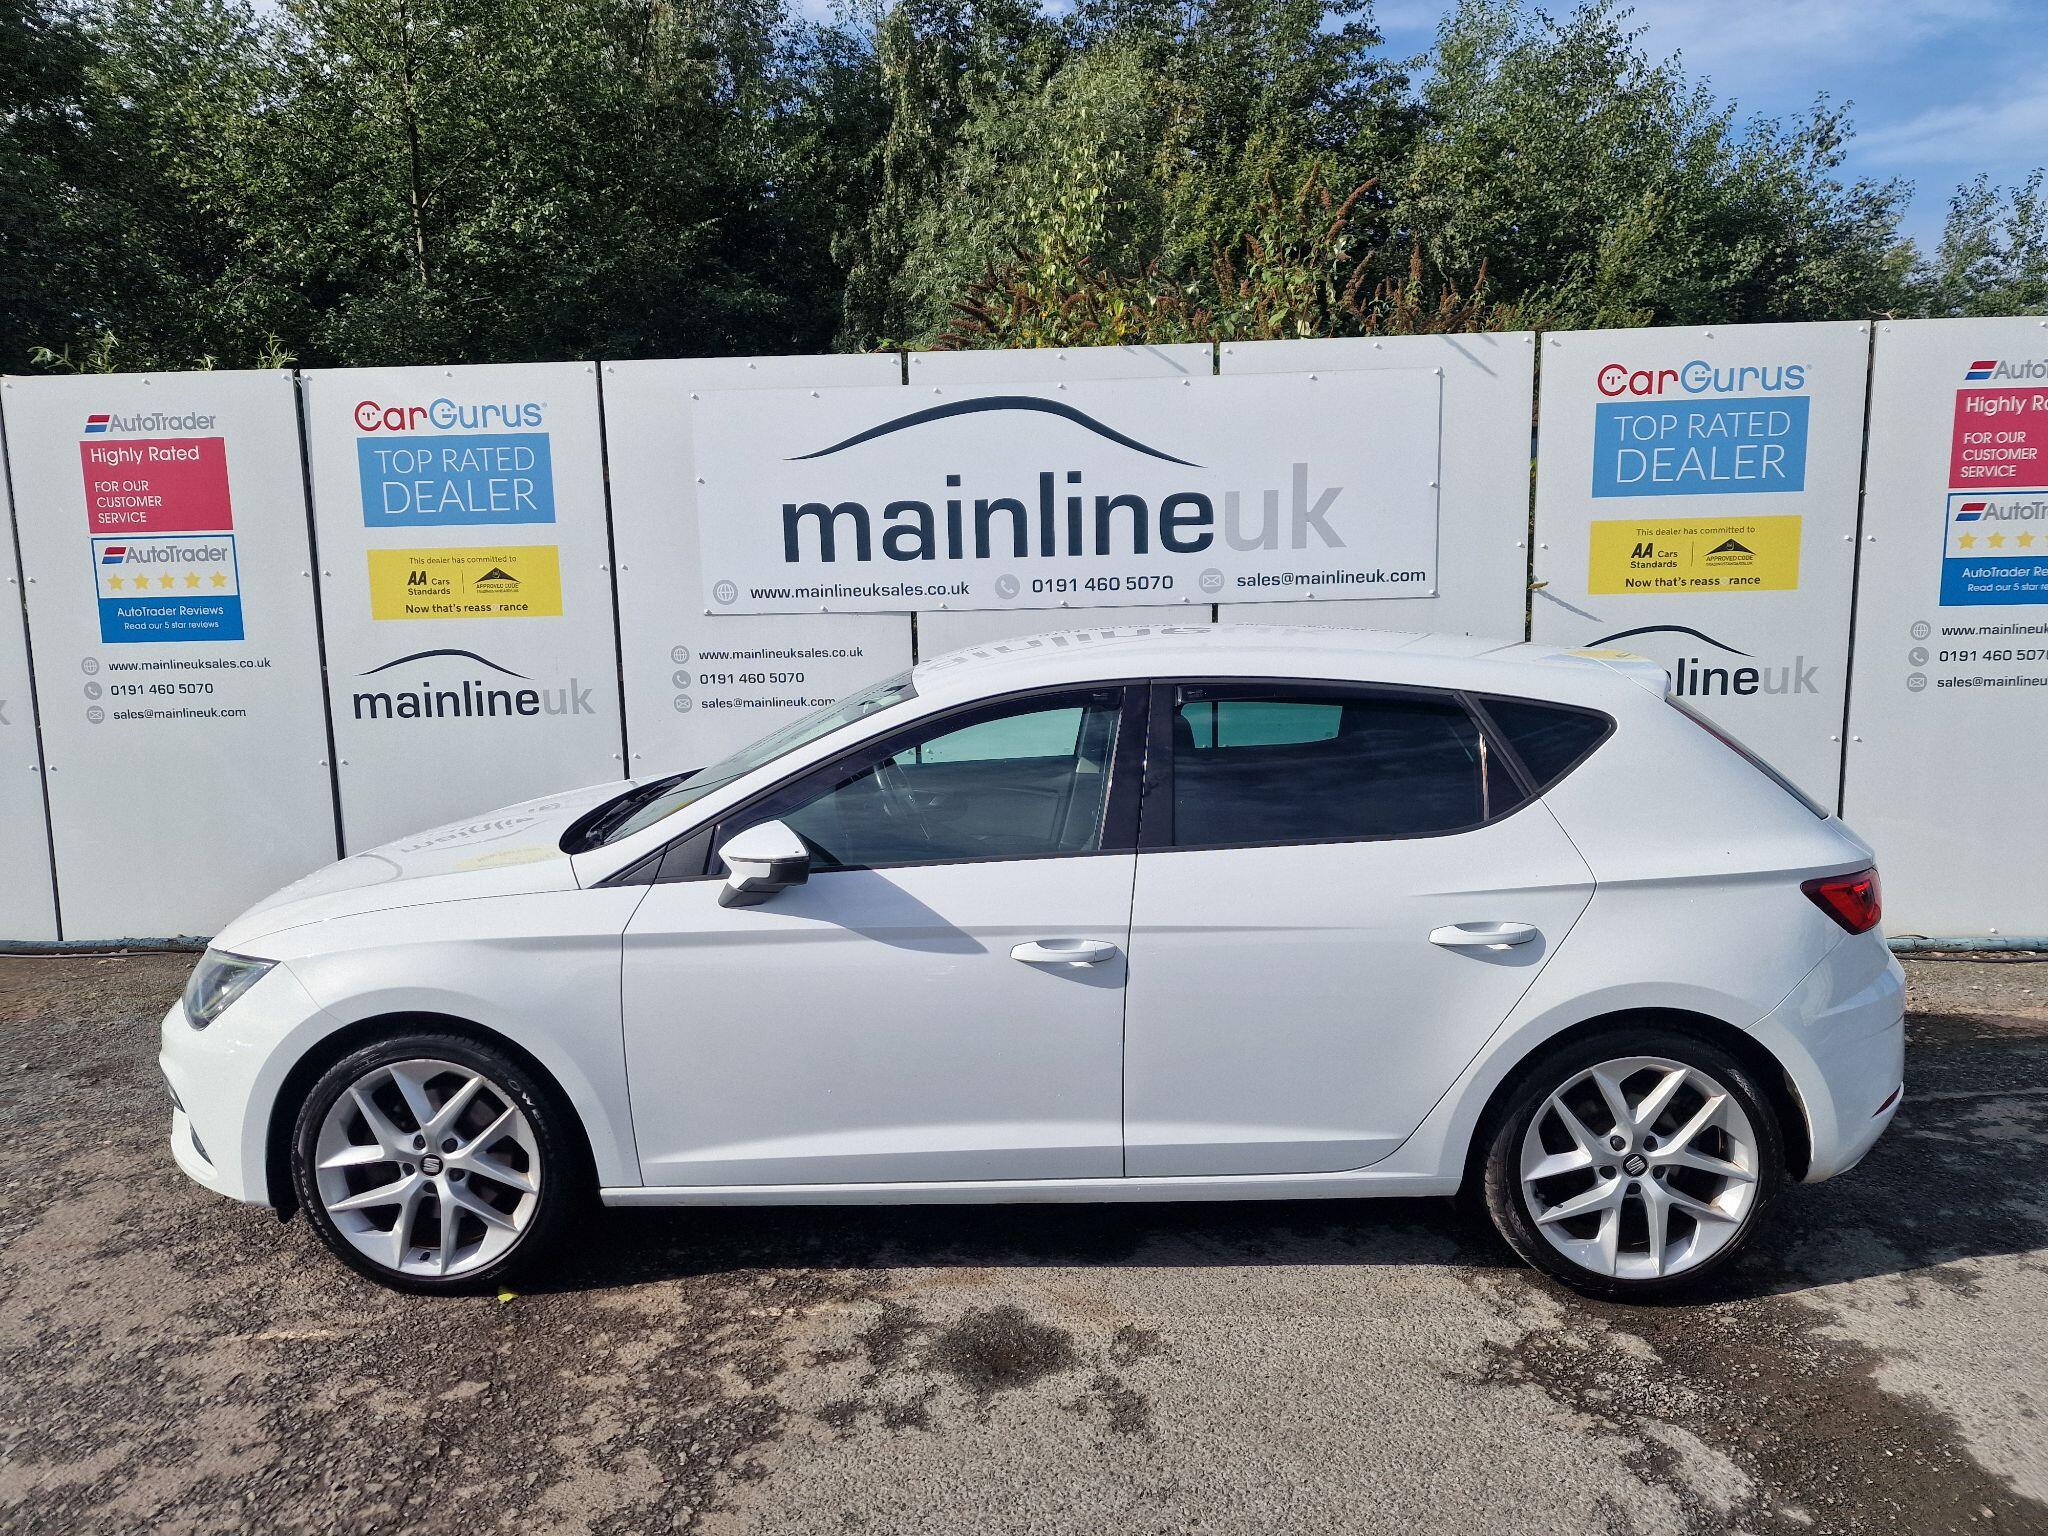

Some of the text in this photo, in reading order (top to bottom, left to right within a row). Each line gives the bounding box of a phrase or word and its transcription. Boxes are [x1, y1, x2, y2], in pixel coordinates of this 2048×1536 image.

[1597, 359, 1805, 397] CarGurus
[1965, 394, 2048, 417] Highly R
[354, 397, 543, 432] CarGurus
[109, 411, 216, 433] AutoTrader
[1614, 410, 1791, 442] TOP RATED
[1963, 431, 2026, 444] FOR OUR
[90, 445, 200, 466] Highly Rated
[374, 446, 535, 475] TOP RATED
[1962, 447, 2038, 461] CUSTOMER
[1616, 443, 1786, 483] DEALER
[1960, 464, 2017, 478] SERVICE
[95, 480, 149, 493] FOR OUR
[97, 495, 162, 508] CUSTOMER
[382, 477, 538, 514] DEALER
[98, 511, 147, 524] SERVICE
[782, 462, 1347, 563] mainlineuk
[1636, 528, 1653, 537] This
[1655, 527, 1681, 536] dealer
[1683, 527, 1698, 535] has
[1699, 526, 1745, 535] committed
[125, 545, 228, 564] AutoTrader
[1630, 542, 1678, 559] AA Cars
[409, 557, 425, 565] This
[427, 556, 450, 564] dealer
[466, 555, 507, 563] committed
[1630, 560, 1678, 569] Standards
[407, 570, 450, 586] AA Cars
[1236, 568, 1426, 588] sales@mainlineuk.com
[1962, 567, 2029, 578] AutoTrader
[1031, 574, 1174, 594] 0191 460 5070
[1625, 577, 1652, 587] Now
[1655, 576, 1687, 587] that's
[1967, 583, 1993, 592] Read
[2013, 583, 2019, 591] 5
[2021, 582, 2038, 591] star
[408, 587, 451, 596] Standards
[750, 581, 970, 599] www.mainlineuksales.co.uk
[117, 605, 224, 618] AutoTrader Reviews
[405, 604, 429, 614] Now
[432, 603, 461, 613] that's
[124, 620, 219, 630] Read our 5 star reviews
[699, 646, 863, 660] www.mainlineuksales.co.uk
[1939, 649, 2048, 662] 0191 460 507
[108, 657, 271, 671] www.mainlineuksales.co.uk
[700, 671, 804, 685] 0191 460 5070
[1665, 655, 1820, 696] lineuk
[110, 682, 214, 696] 0191 460 5070
[352, 678, 596, 719] mainlineuk
[701, 696, 836, 710] sales@mainlineuk.com
[113, 706, 247, 721] sales@mainlineuk.com
